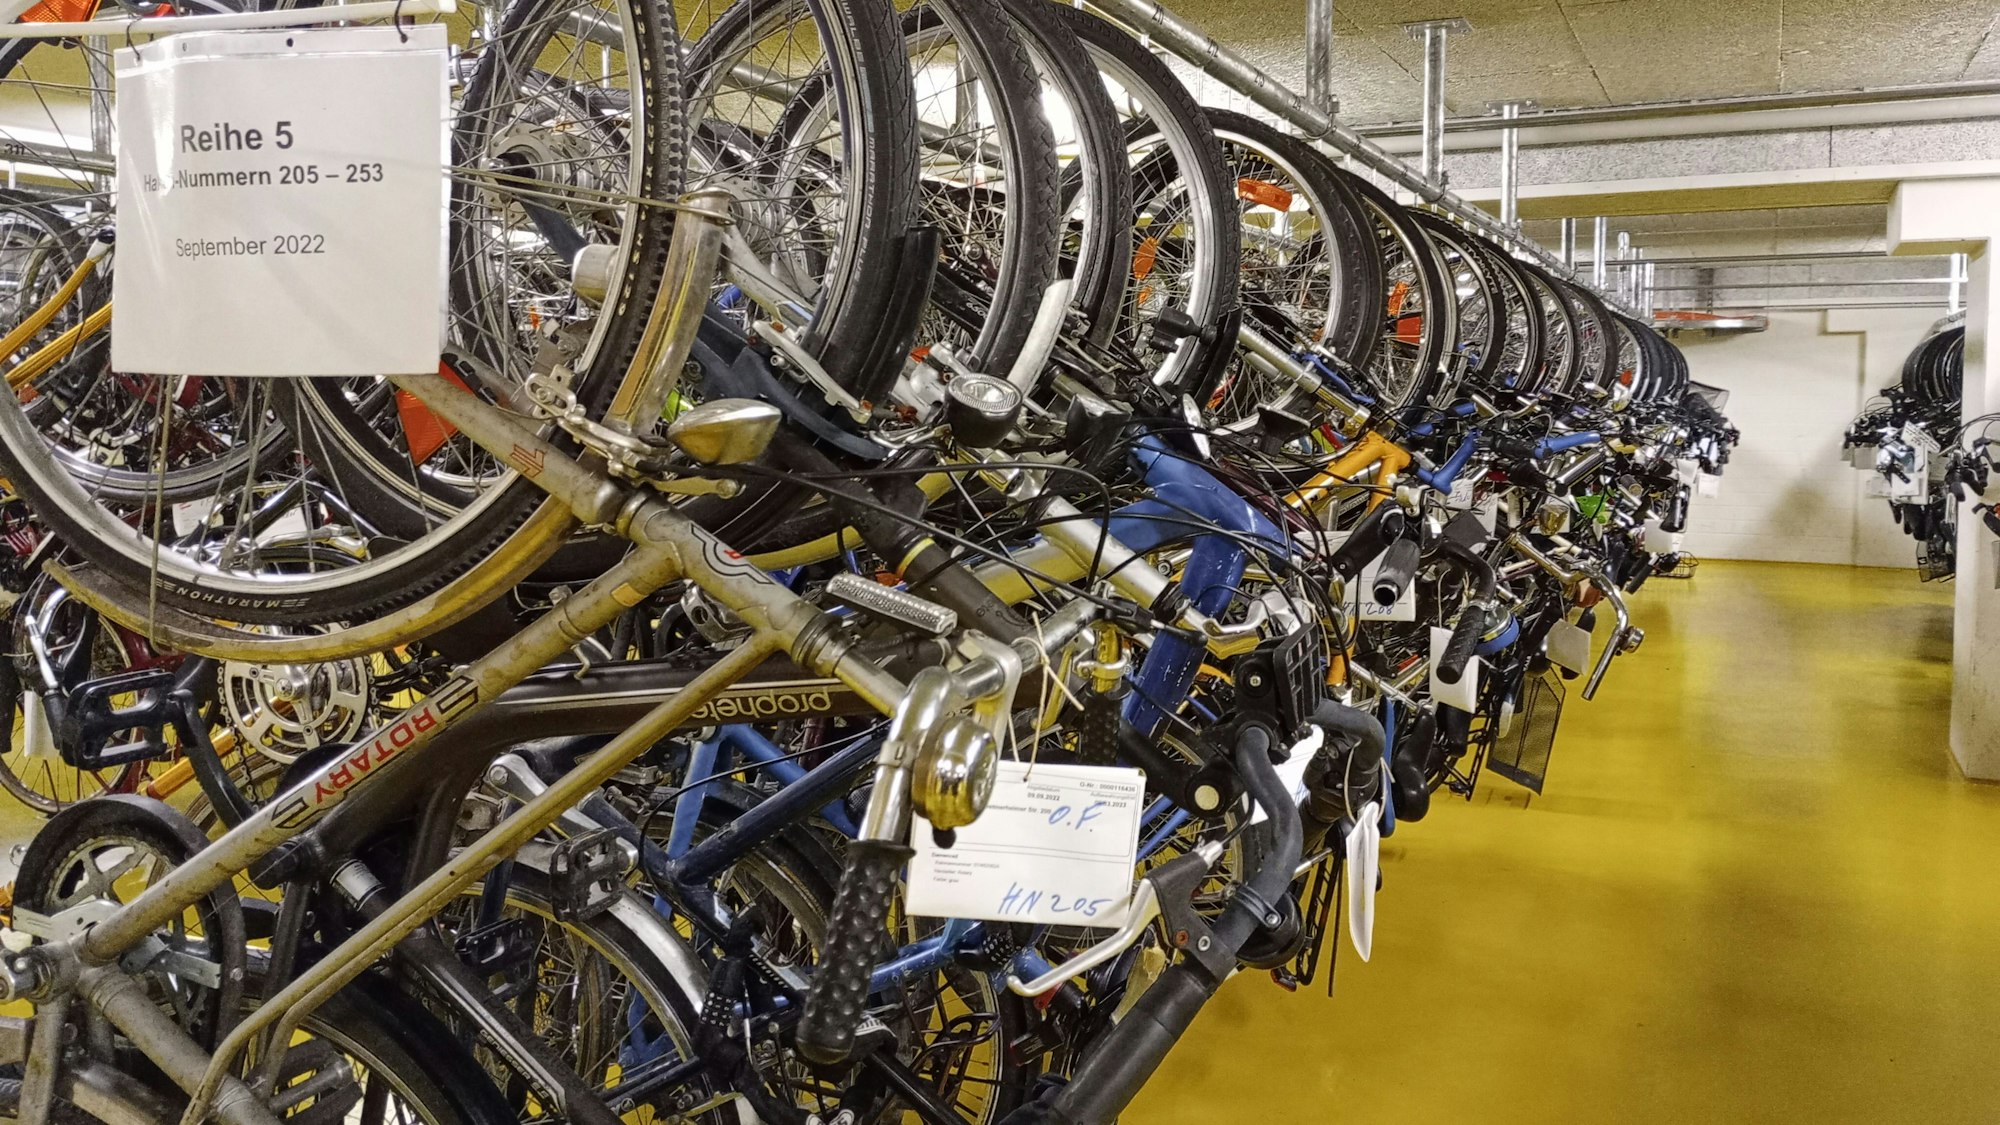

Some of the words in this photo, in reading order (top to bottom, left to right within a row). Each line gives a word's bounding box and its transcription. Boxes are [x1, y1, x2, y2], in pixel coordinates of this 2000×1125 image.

[180, 122, 263, 153] Reihe
[275, 121, 294, 150] 5
[143, 169, 272, 192] Ha-Nummern
[279, 165, 319, 185] 205
[346, 163, 384, 183] 253
[865, 137, 876, 230] MARATHON
[176, 236, 267, 261] September
[273, 234, 325, 254] 2022
[176, 586, 281, 609] MARATHON
[315, 706, 438, 804] ROTARY
[997, 882, 1044, 916] HN
[1050, 894, 1113, 917] 205
